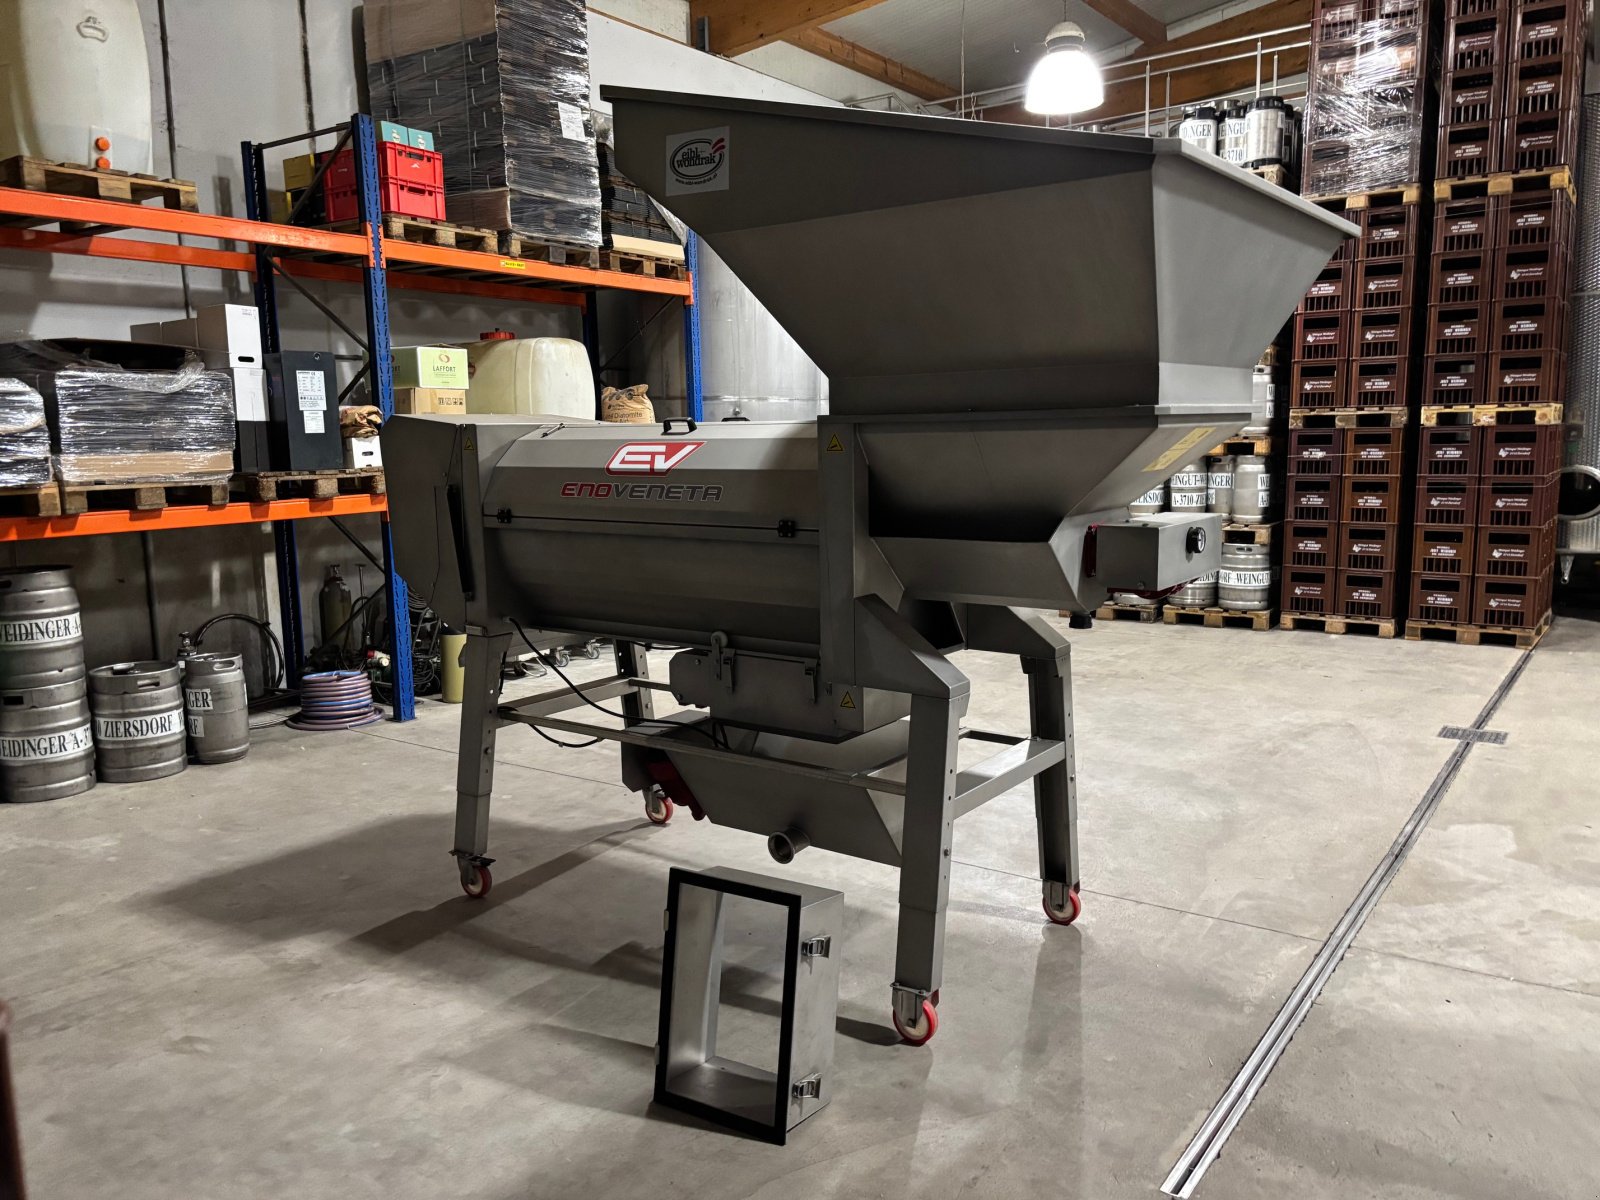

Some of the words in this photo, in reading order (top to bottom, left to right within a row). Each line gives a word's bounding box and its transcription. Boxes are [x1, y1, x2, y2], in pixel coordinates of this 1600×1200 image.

[432, 365, 456, 373] LAFFORT
[609, 445, 698, 472] EV
[561, 482, 724, 502] ENOVENETA
[103, 714, 173, 738] ZIERSDORF
